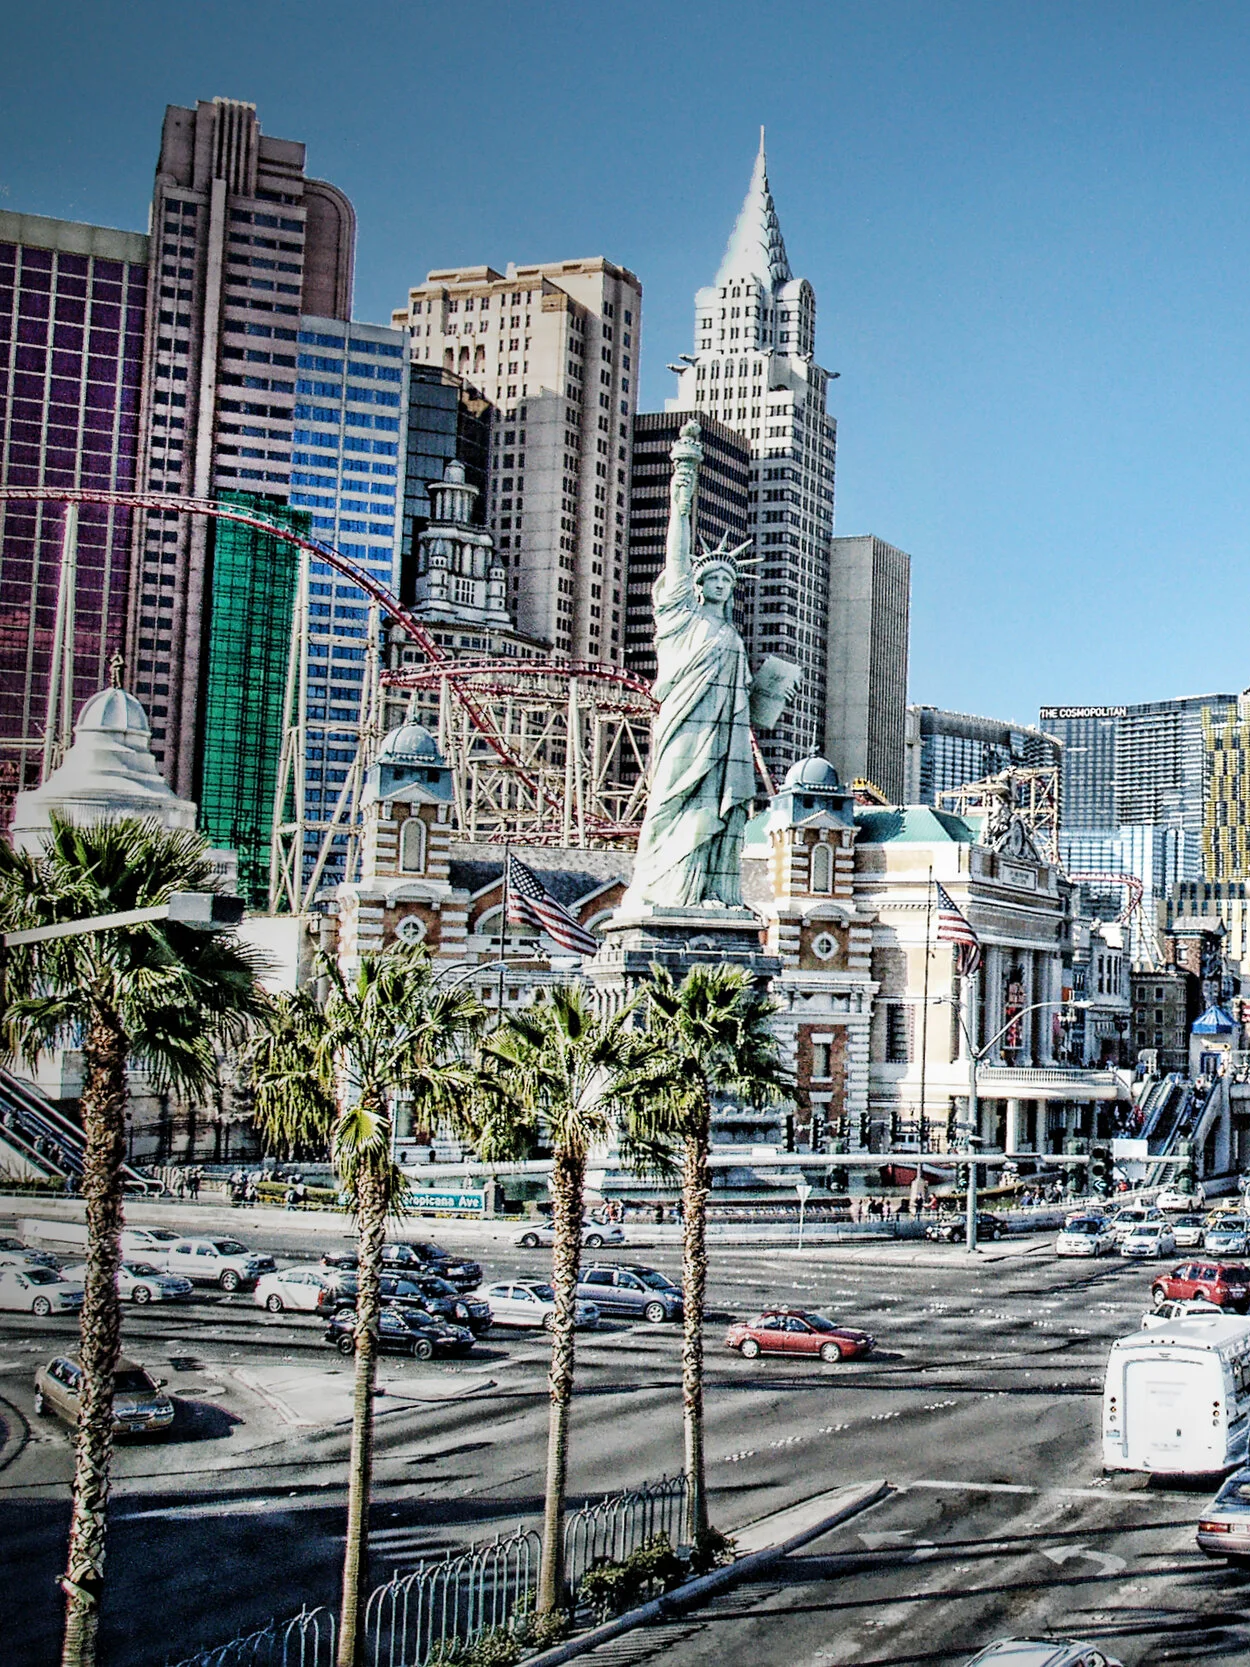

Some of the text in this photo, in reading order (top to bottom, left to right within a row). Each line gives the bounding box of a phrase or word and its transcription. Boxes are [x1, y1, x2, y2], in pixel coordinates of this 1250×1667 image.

[1040, 706, 1127, 719] THE COSMOPOLITAN
[459, 1195, 480, 1207] Ave
